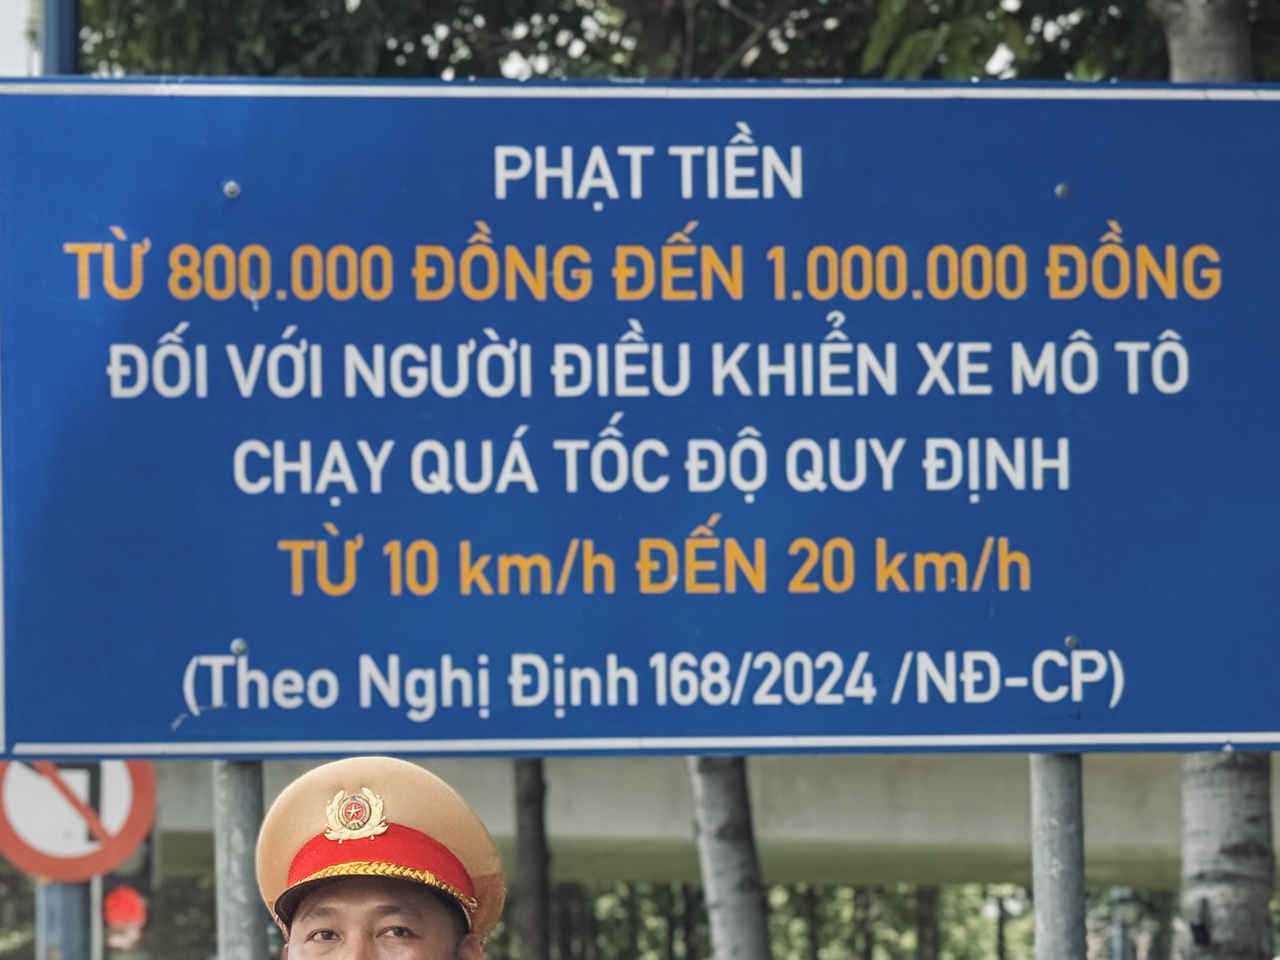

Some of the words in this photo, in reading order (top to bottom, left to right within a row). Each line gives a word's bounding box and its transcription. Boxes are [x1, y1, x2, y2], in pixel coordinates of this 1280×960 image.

[495, 146, 654, 211] PHẠT
[669, 122, 802, 198] TIỀN
[64, 226, 151, 300] TỪ
[168, 244, 393, 301] 800.000
[412, 221, 592, 301] ĐỒNG
[612, 221, 742, 300] ĐẾN
[766, 244, 1026, 301] 1.000.000
[1046, 221, 1222, 300] ĐỒNG
[107, 322, 207, 398] ĐỐI
[227, 326, 322, 398] VỚI
[345, 328, 532, 398] NGƯỜI
[551, 320, 690, 397] ĐIỀU
[712, 311, 897, 397] KHIỂN
[917, 342, 992, 395] XE
[1011, 330, 1099, 395] MÔ
[1115, 330, 1189, 394] TÔ
[234, 440, 395, 507] CHẠY
[412, 426, 538, 494] QUÁ
[553, 412, 670, 493] TỐC
[685, 426, 767, 503] ĐỘ
[786, 438, 906, 496] QUY
[923, 438, 1069, 503] ĐỊNH
[277, 523, 364, 597] TỪ
[383, 539, 439, 596] 10
[460, 539, 615, 595] km/h
[636, 514, 767, 594] ĐẾN
[788, 538, 855, 594] 20
[876, 536, 1031, 592] km/h
[183, 652, 339, 716] (Theo
[360, 654, 490, 722] Nghị
[508, 653, 638, 718] Định
[649, 650, 877, 706] 168/2024
[892, 648, 1124, 708] /NĐ-CP)
